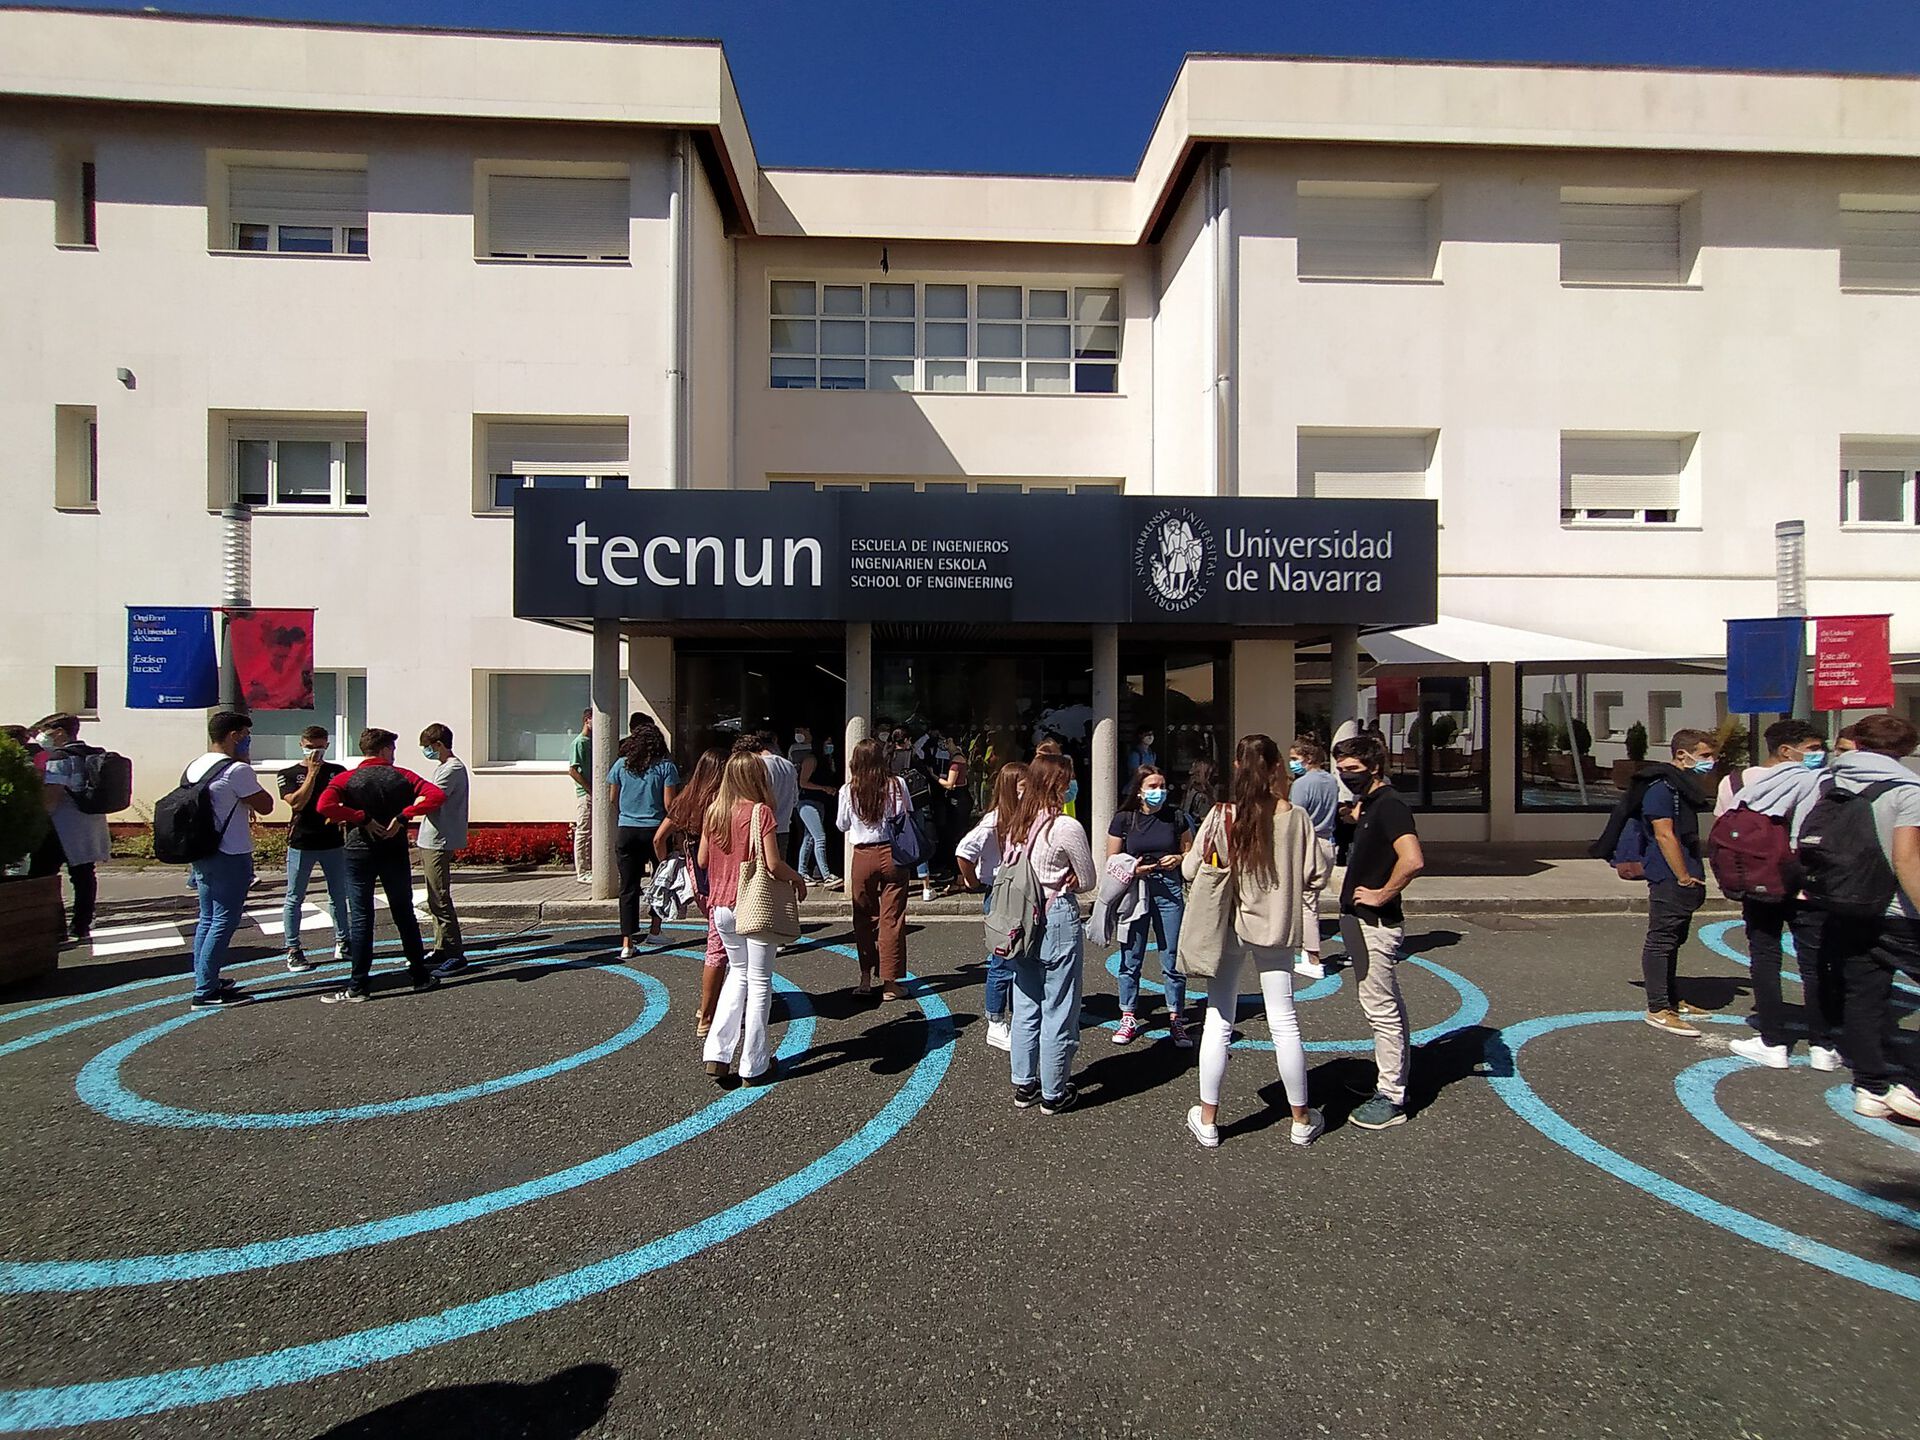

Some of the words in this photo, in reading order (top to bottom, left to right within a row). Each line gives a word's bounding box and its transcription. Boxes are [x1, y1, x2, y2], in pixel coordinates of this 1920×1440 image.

[567, 520, 823, 588] tecnun
[851, 539, 907, 552] ESCUELA
[911, 540, 928, 553] DE
[932, 540, 1010, 554] INGENIEROS
[1225, 528, 1393, 560] Universidad
[851, 557, 934, 571] INGENIARIEN
[938, 558, 987, 571] ESKOLA
[850, 575, 902, 589] SCHOOL
[906, 576, 923, 589] OF
[927, 576, 1013, 590] ENGINEERING
[1225, 563, 1259, 592] de
[1269, 563, 1383, 593] Navarra
